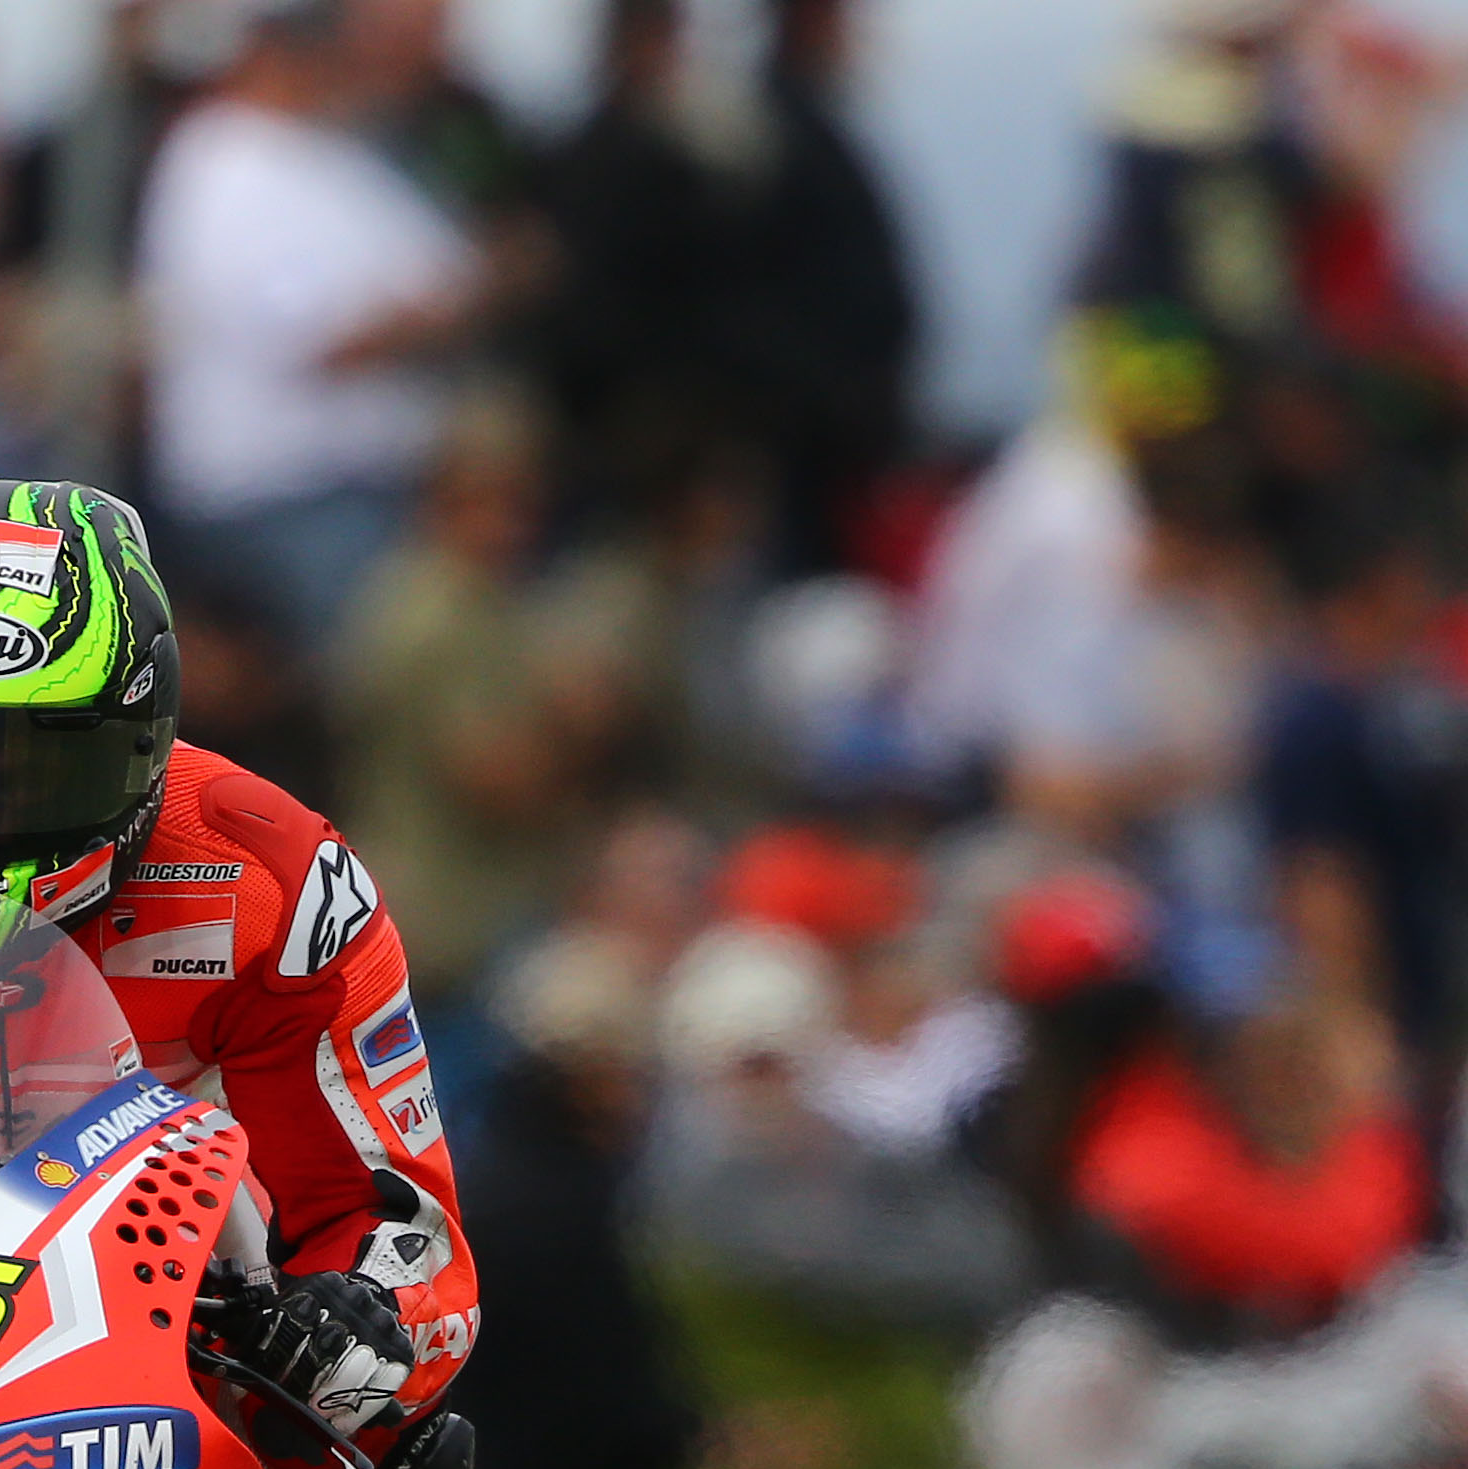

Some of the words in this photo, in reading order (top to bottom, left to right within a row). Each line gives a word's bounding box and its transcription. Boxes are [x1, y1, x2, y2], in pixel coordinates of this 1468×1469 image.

[135, 864, 241, 880] IDGESTONE
[152, 959, 226, 974] DUCATI
[75, 1084, 186, 1169] ADVANCE
